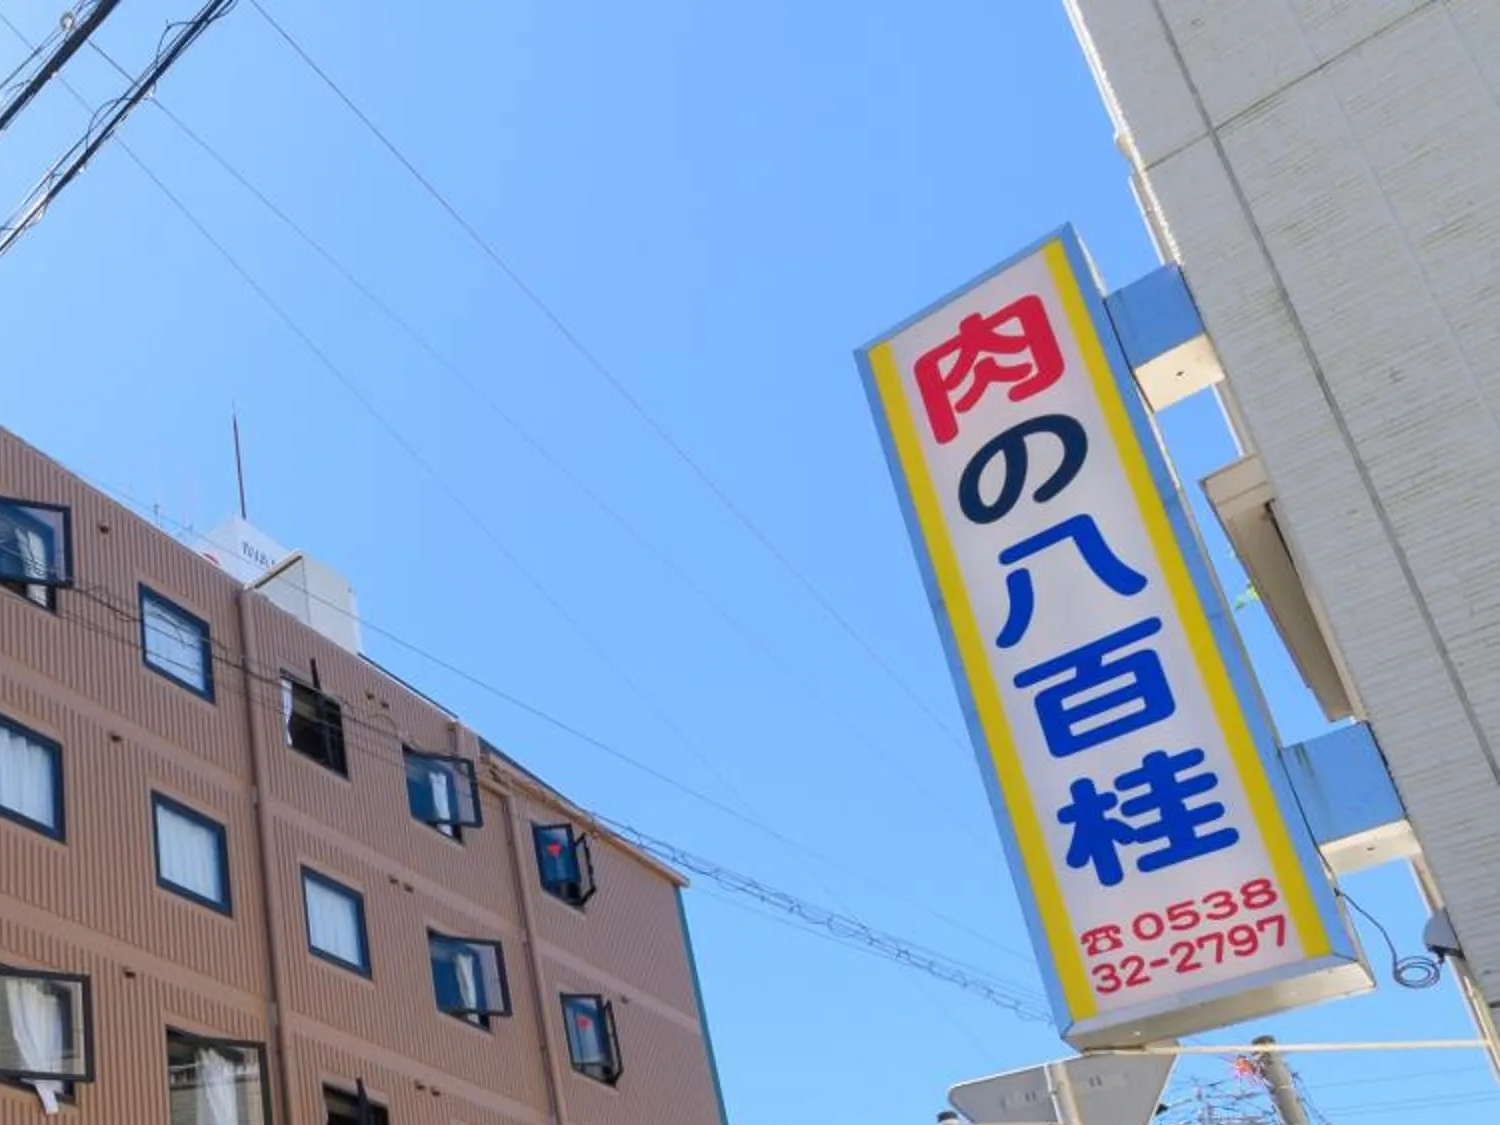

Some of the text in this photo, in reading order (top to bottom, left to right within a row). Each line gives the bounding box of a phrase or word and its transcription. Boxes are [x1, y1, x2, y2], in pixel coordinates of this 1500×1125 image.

[913, 293, 1240, 888] 肉の八百桂
[1131, 877, 1278, 941] 0538
[1091, 914, 1286, 994] 32-2797
